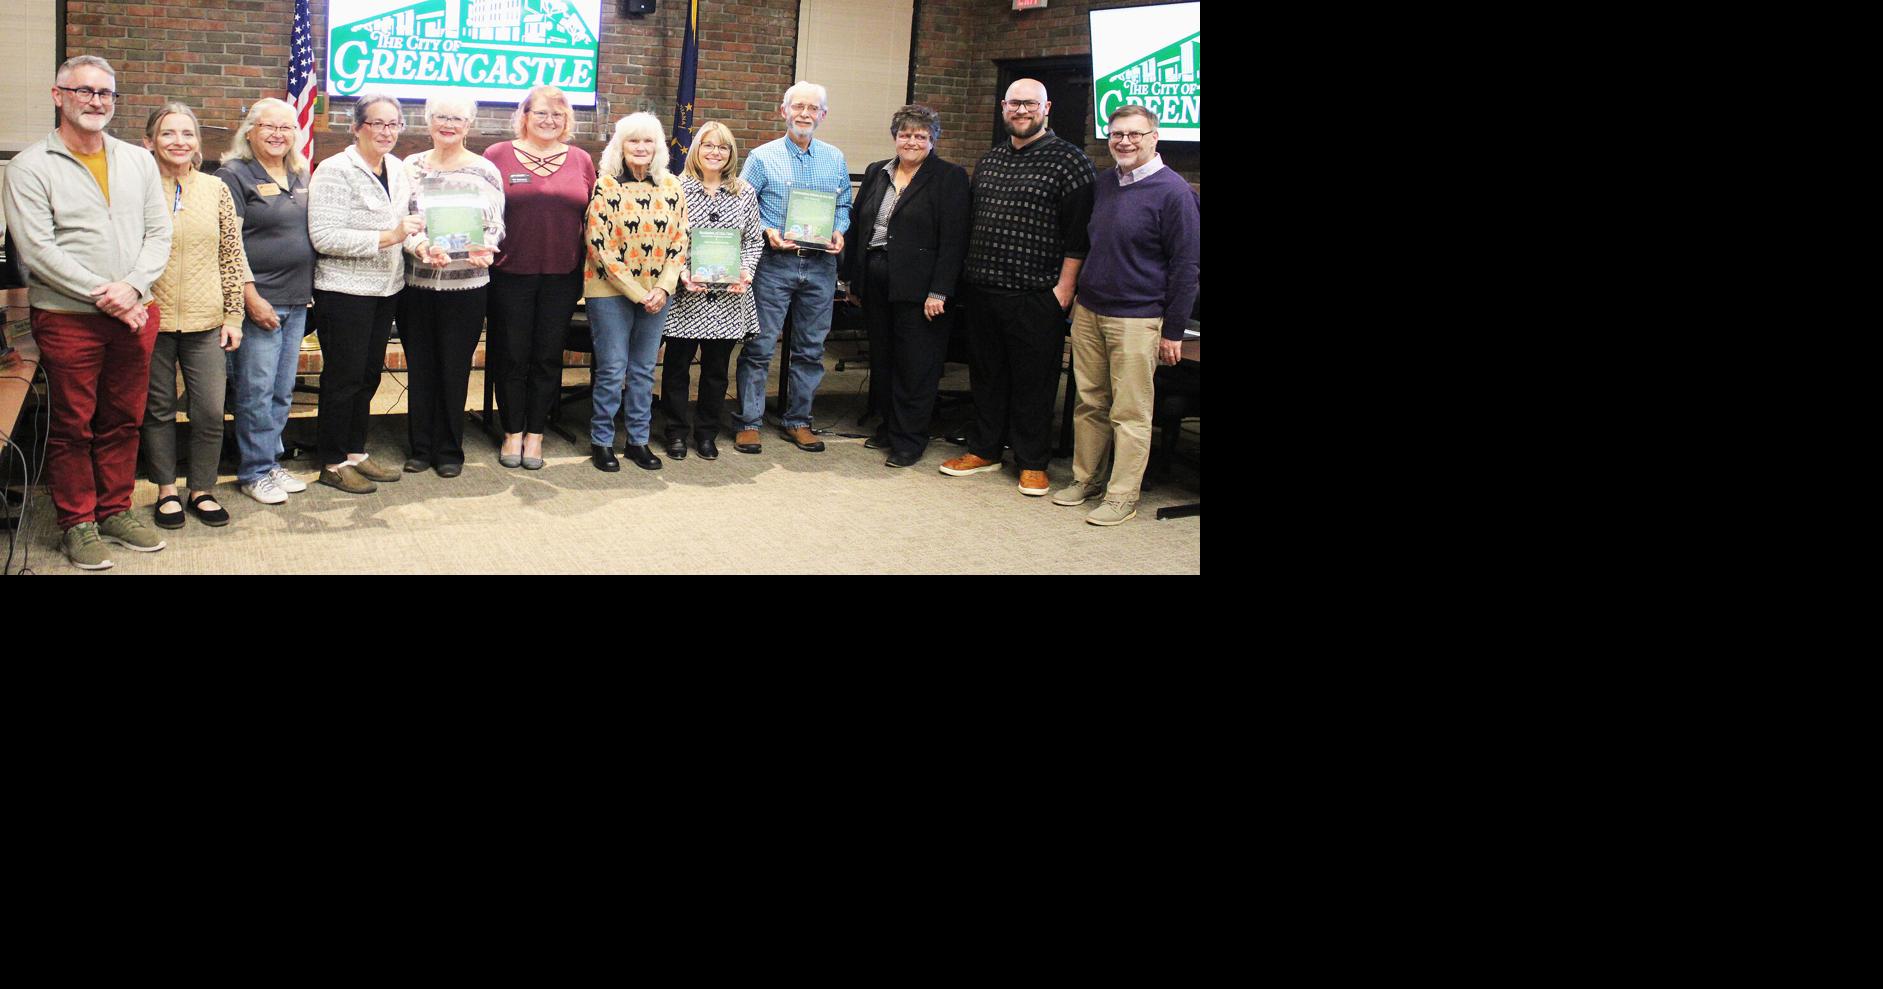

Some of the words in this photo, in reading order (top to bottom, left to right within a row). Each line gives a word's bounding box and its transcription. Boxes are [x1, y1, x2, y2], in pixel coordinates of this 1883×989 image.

[370, 31, 404, 49] THE
[406, 35, 442, 51] CITY
[442, 39, 462, 52] OF
[333, 40, 594, 93] GREENCASTLE
[1123, 80, 1149, 95] THE
[1151, 81, 1179, 96] CITY
[1180, 83, 1198, 95] OF
